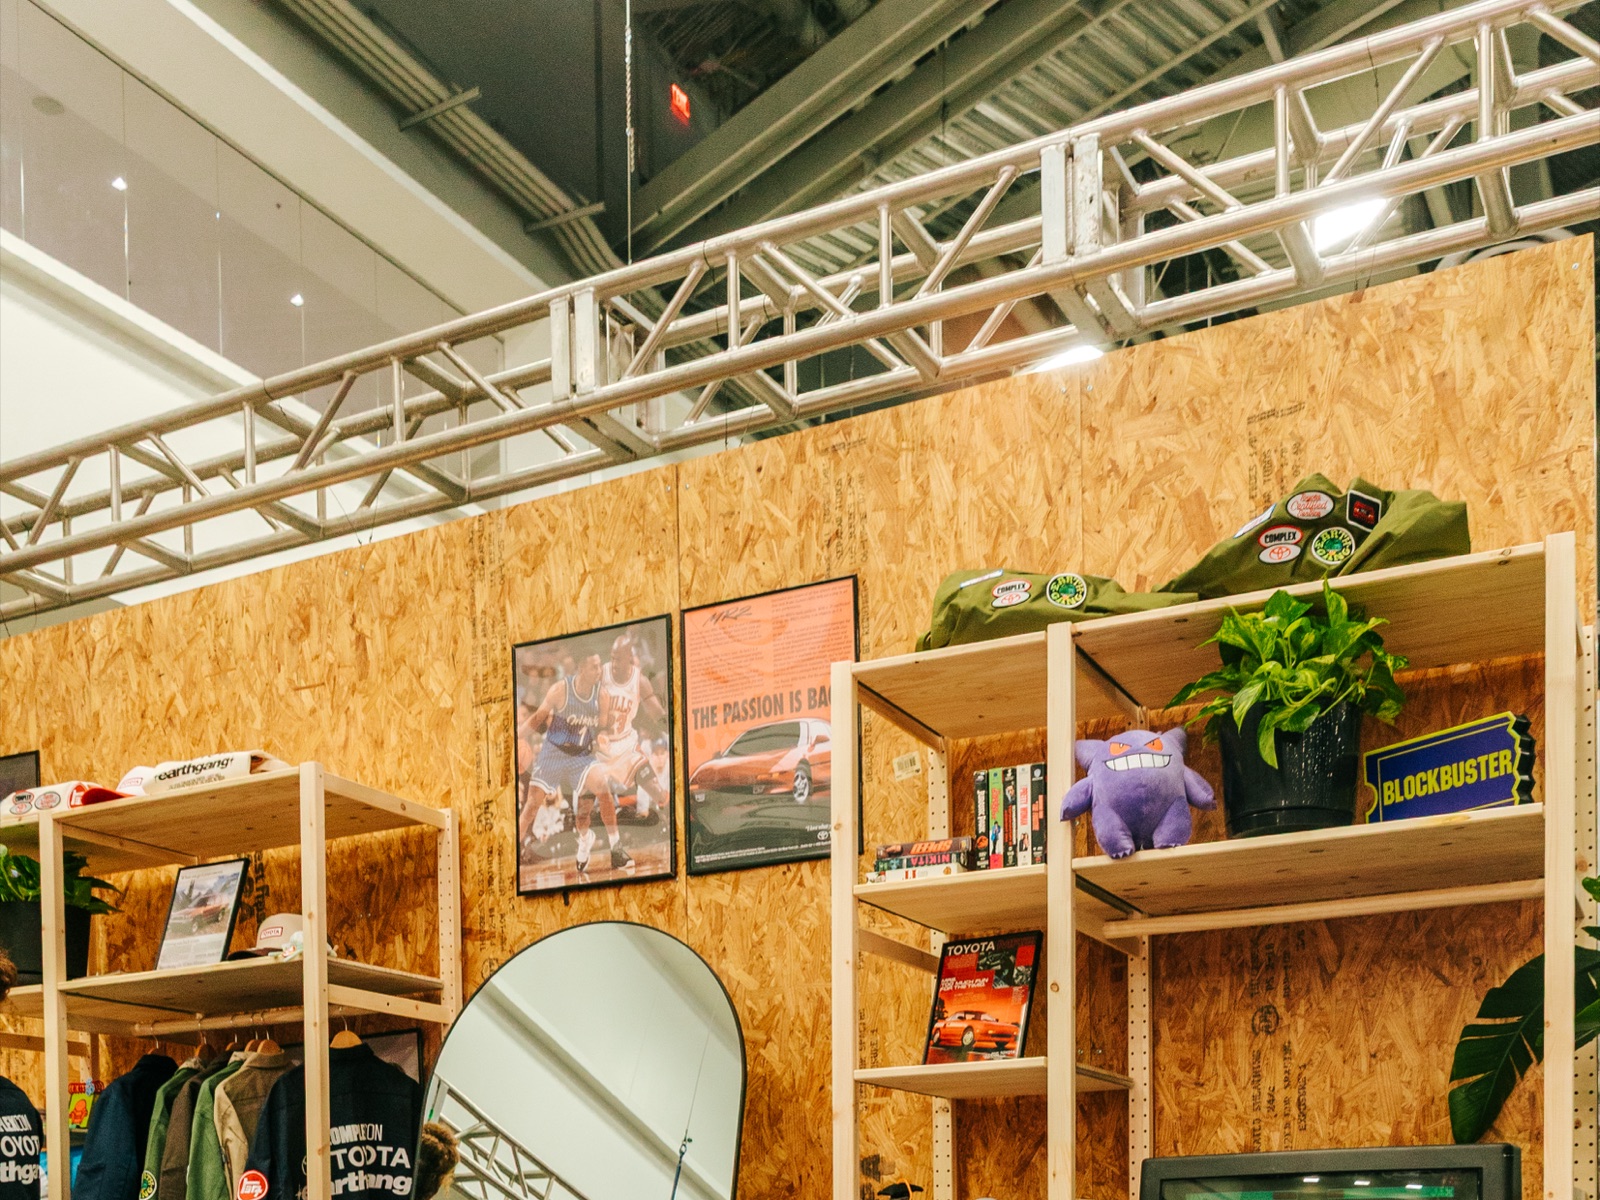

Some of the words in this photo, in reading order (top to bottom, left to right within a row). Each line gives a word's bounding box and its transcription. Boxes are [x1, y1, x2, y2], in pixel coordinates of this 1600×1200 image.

[1264, 531, 1297, 544] COMPLEX
[1315, 529, 1352, 550] EARTH
[1316, 547, 1351, 562] GANG
[996, 582, 1026, 595] COMPLEX
[1050, 575, 1084, 594] EARTH
[1050, 592, 1083, 606] GANG
[703, 606, 753, 627] MR2
[691, 704, 719, 731] THE
[723, 691, 785, 725] PASSION
[789, 689, 803, 713] IS
[1382, 749, 1513, 806] BLOCKBUSTER
[910, 839, 953, 855] SPEED
[911, 853, 951, 867] NIKITA
[947, 941, 995, 956] TOYOTA
[330, 1145, 411, 1170] TOOTA
